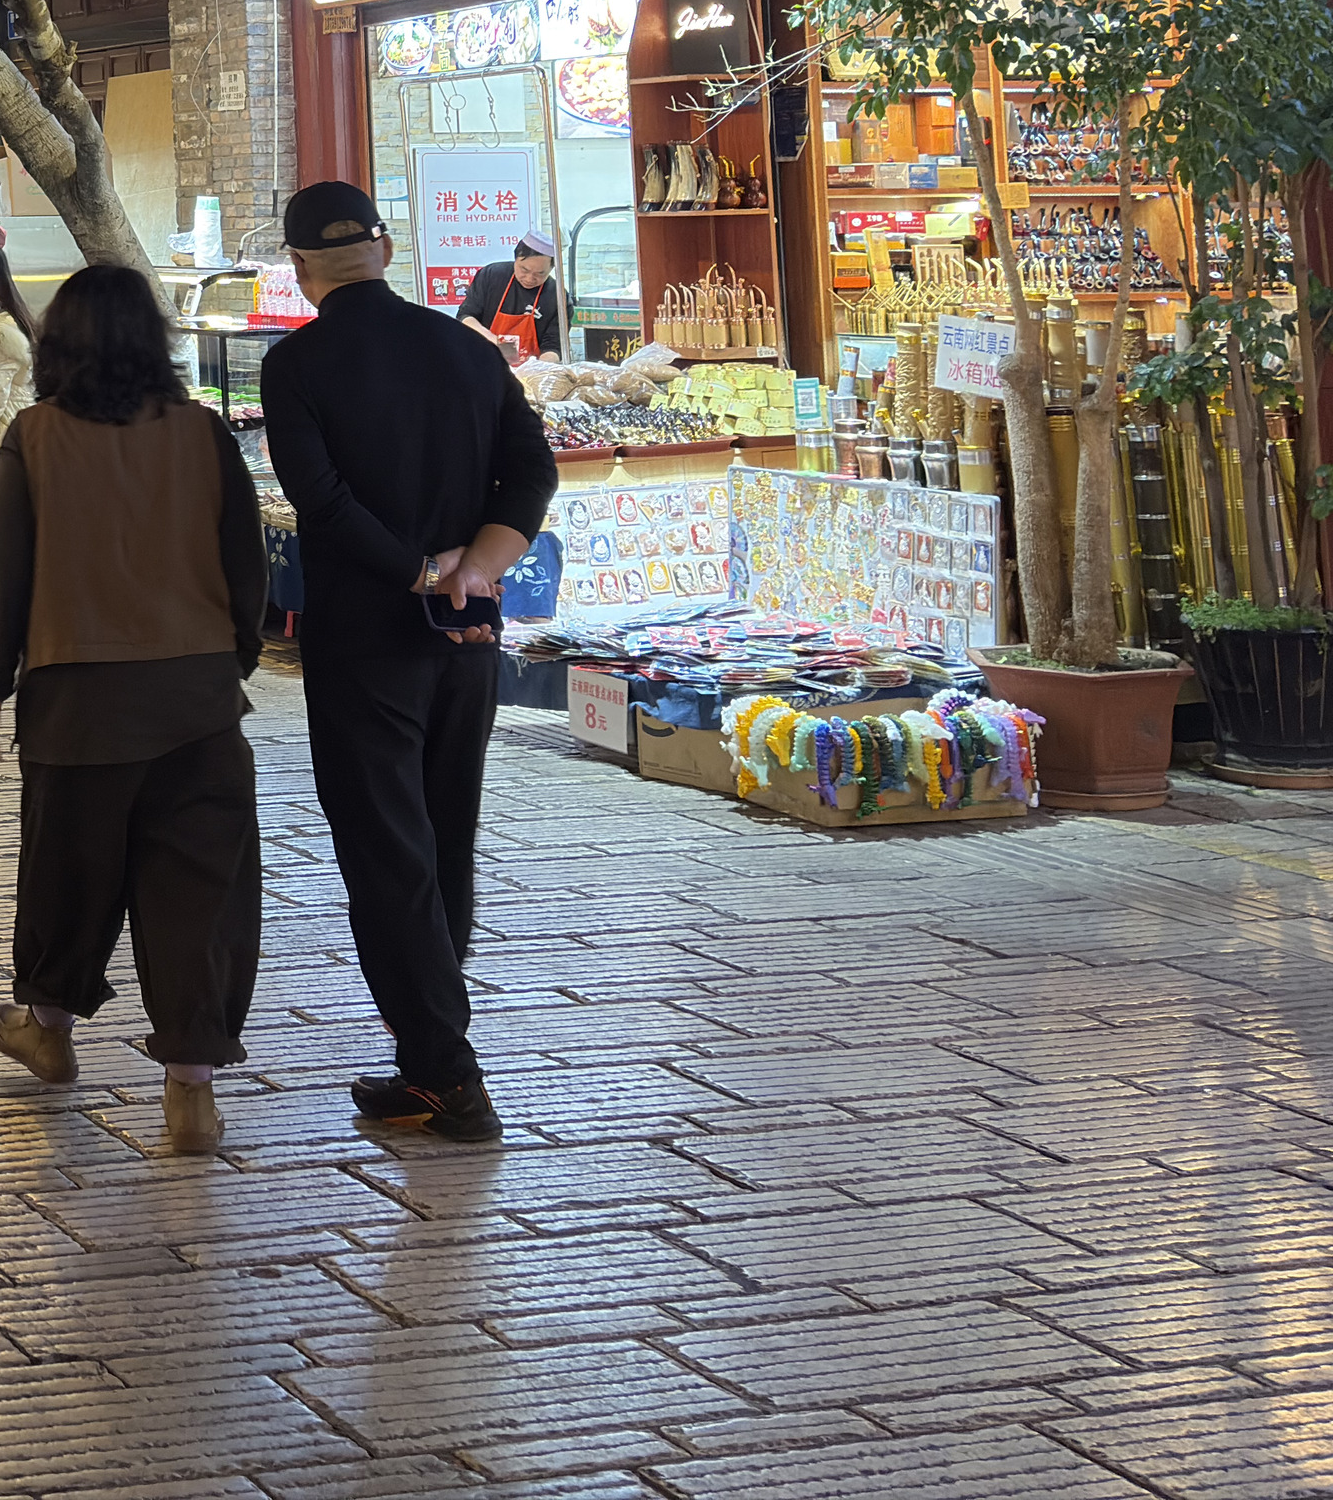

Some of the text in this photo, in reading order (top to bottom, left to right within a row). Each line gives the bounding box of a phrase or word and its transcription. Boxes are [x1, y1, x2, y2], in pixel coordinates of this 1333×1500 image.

[435, 190, 519, 212] 消火栓
[436, 213, 518, 223] FIRE HYDRANT
[499, 236, 519, 246] 119
[943, 325, 1010, 355] 云南网红景点
[946, 358, 1002, 389] 冰箱贴
[585, 702, 608, 731] 8元
